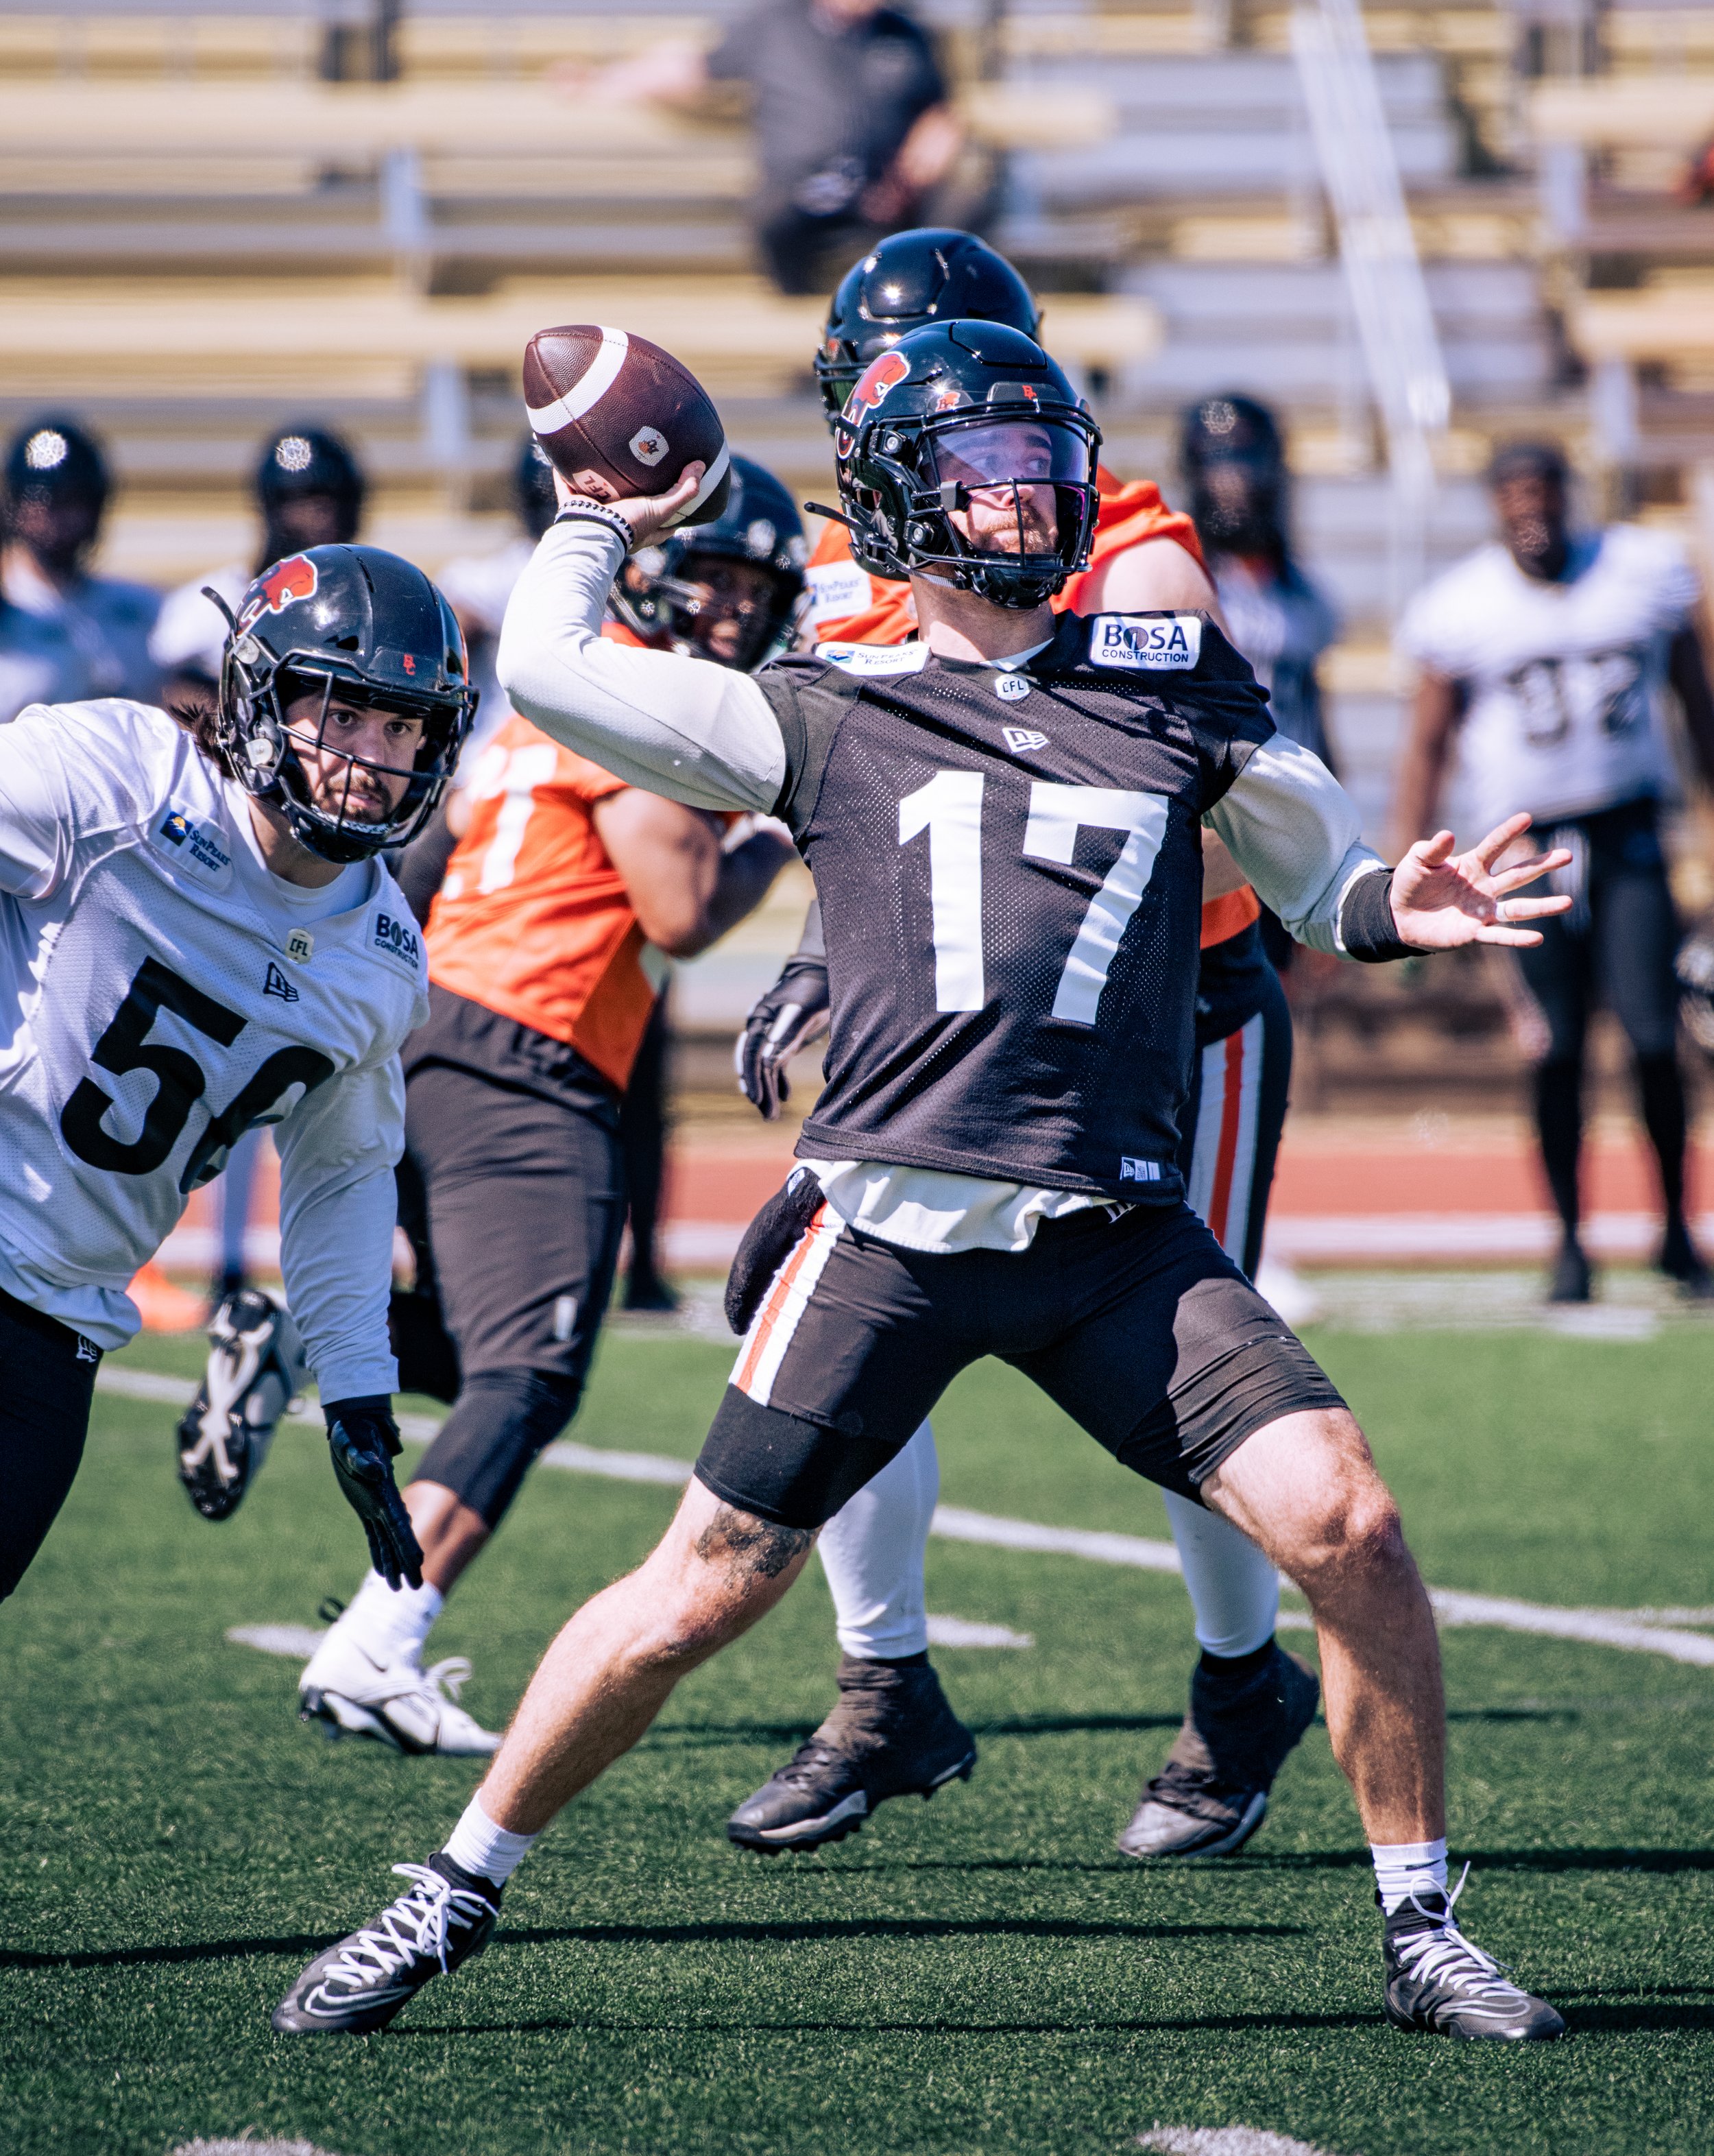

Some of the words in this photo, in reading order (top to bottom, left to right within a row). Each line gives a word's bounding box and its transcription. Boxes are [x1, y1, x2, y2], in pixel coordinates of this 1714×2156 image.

[583, 475, 612, 500] CFL
[1103, 624, 1189, 651] BOSA
[1102, 649, 1189, 662] CONSTRUCTION
[1002, 680, 1024, 693] CFL
[899, 770, 1169, 1026] 17
[289, 937, 308, 957] CFL
[376, 913, 419, 961] BOSA
[374, 937, 419, 970] CONSTRUCTION
